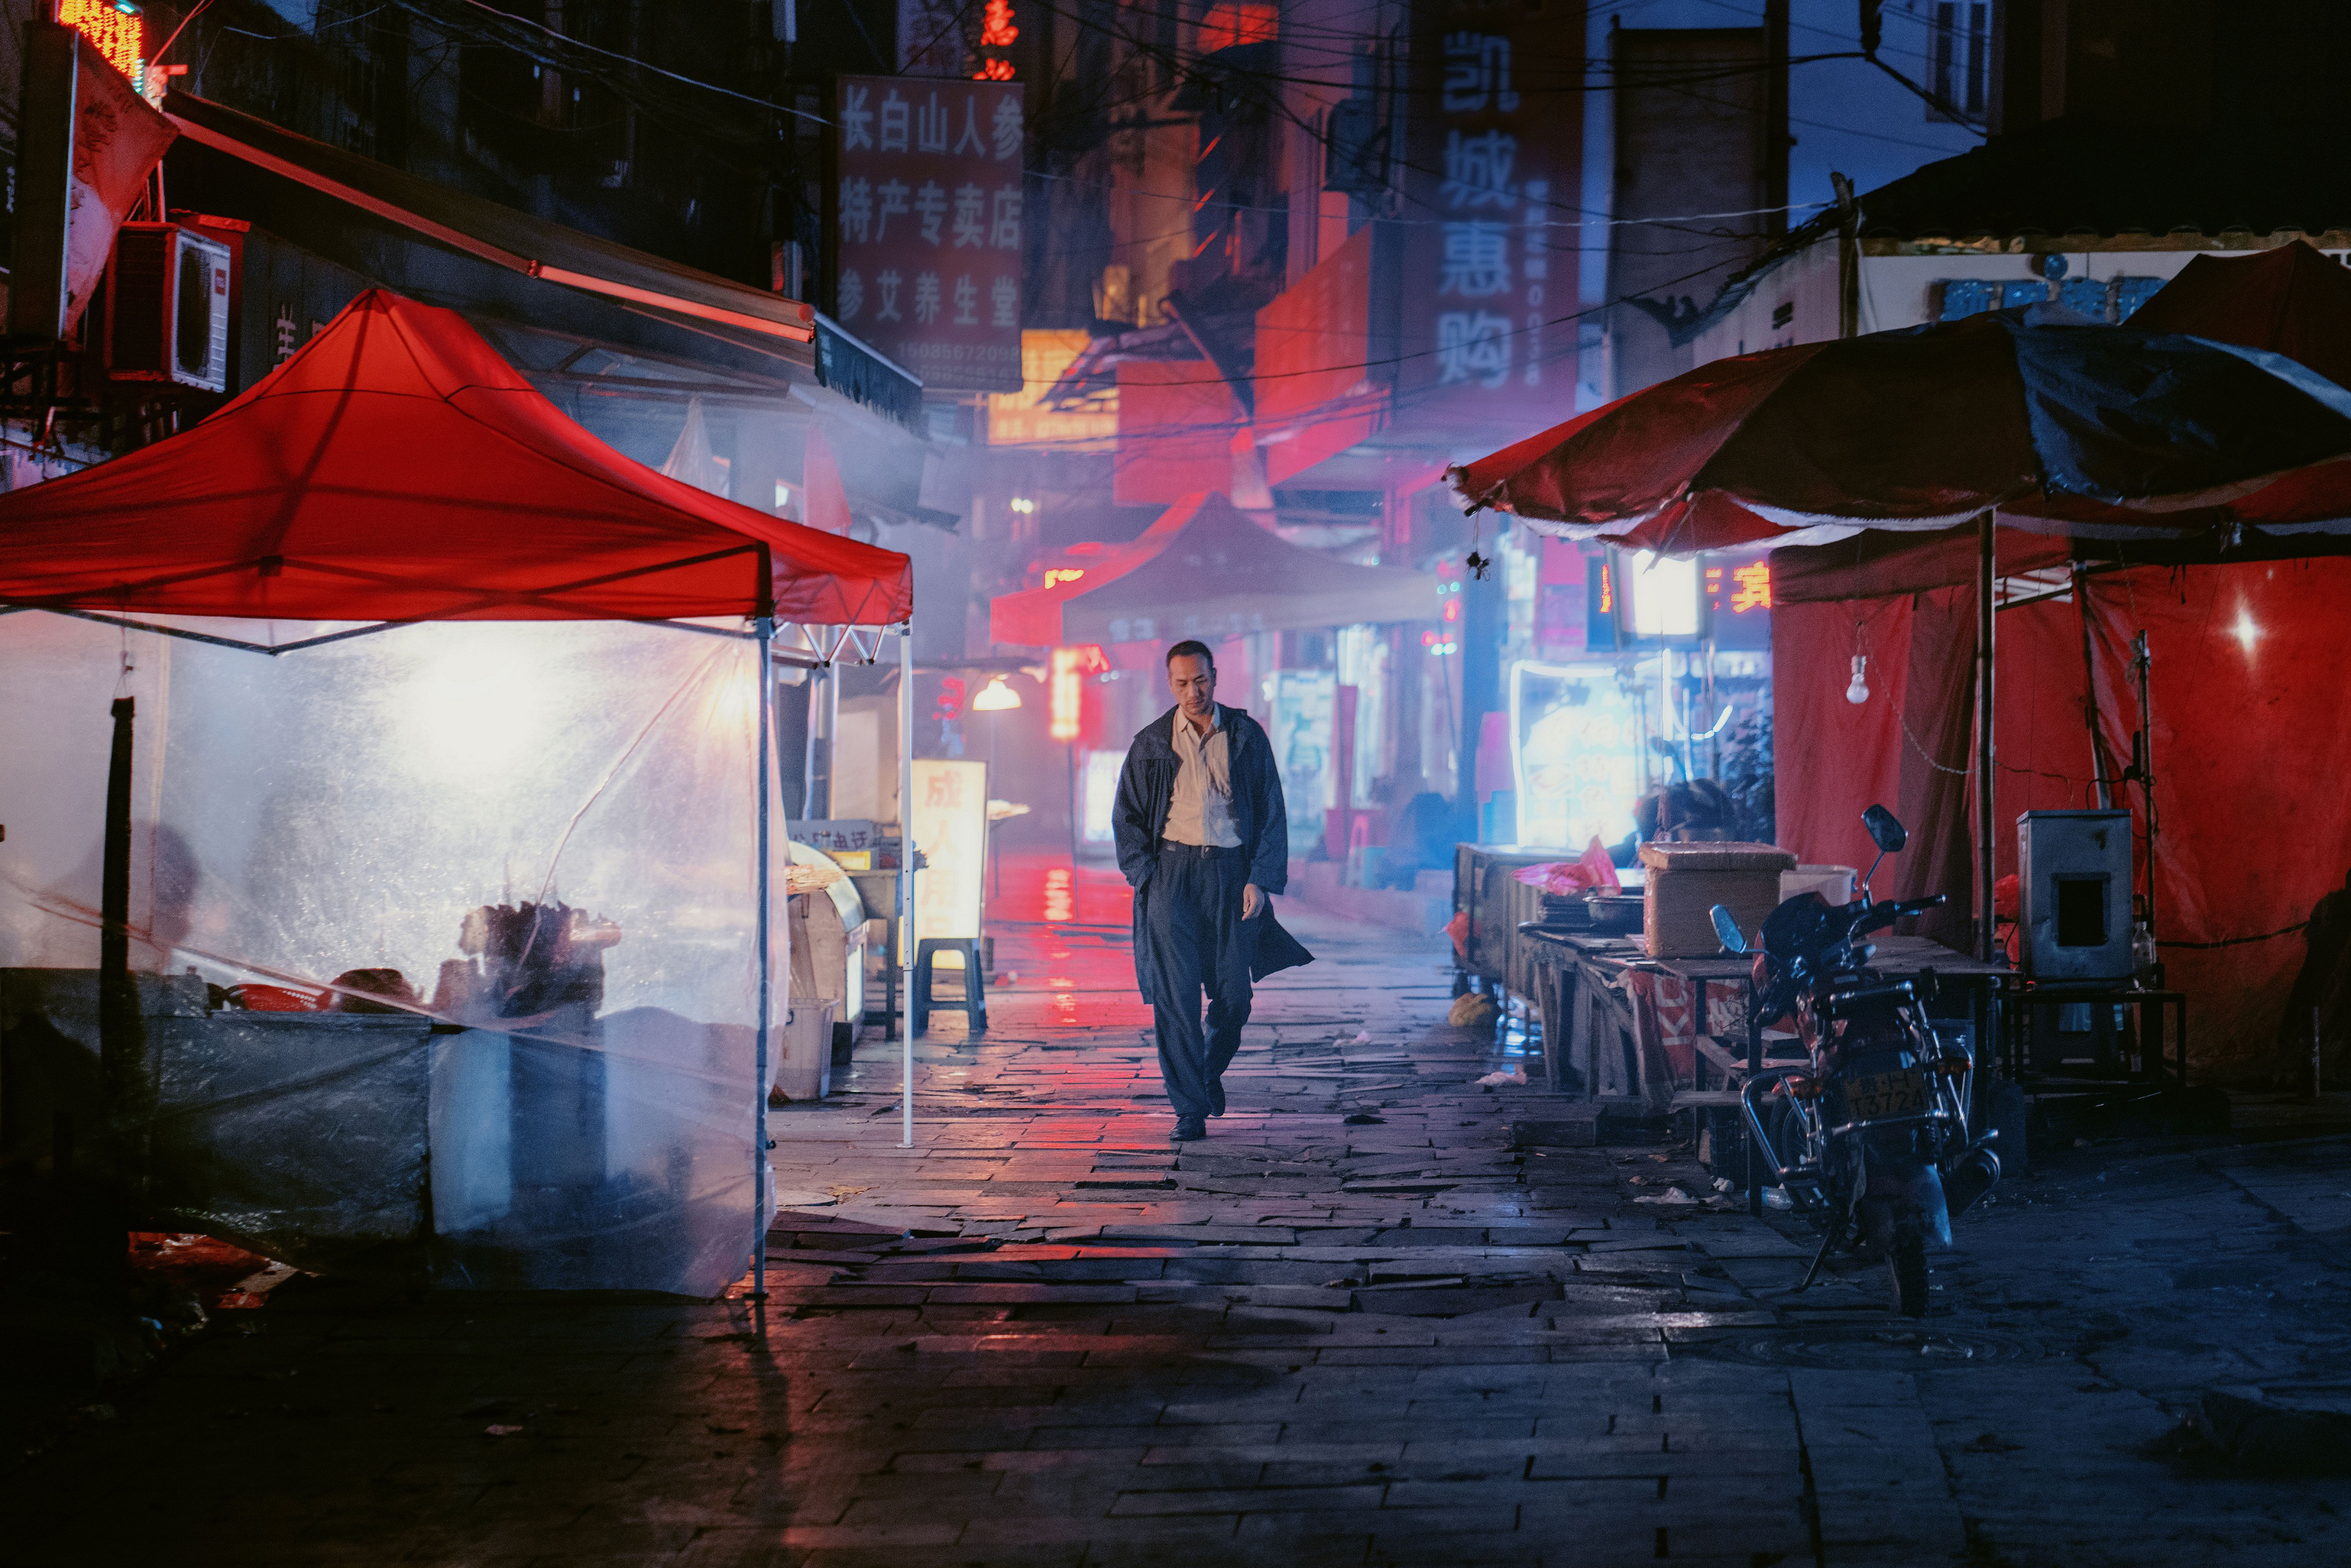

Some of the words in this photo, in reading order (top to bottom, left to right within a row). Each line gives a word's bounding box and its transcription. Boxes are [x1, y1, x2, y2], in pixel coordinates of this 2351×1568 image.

[842, 85, 1024, 160] 长白山人参
[838, 175, 1022, 248] 特产专卖店
[1439, 30, 1520, 388] 凯城惠购
[837, 268, 1017, 326] 参艾养生堂
